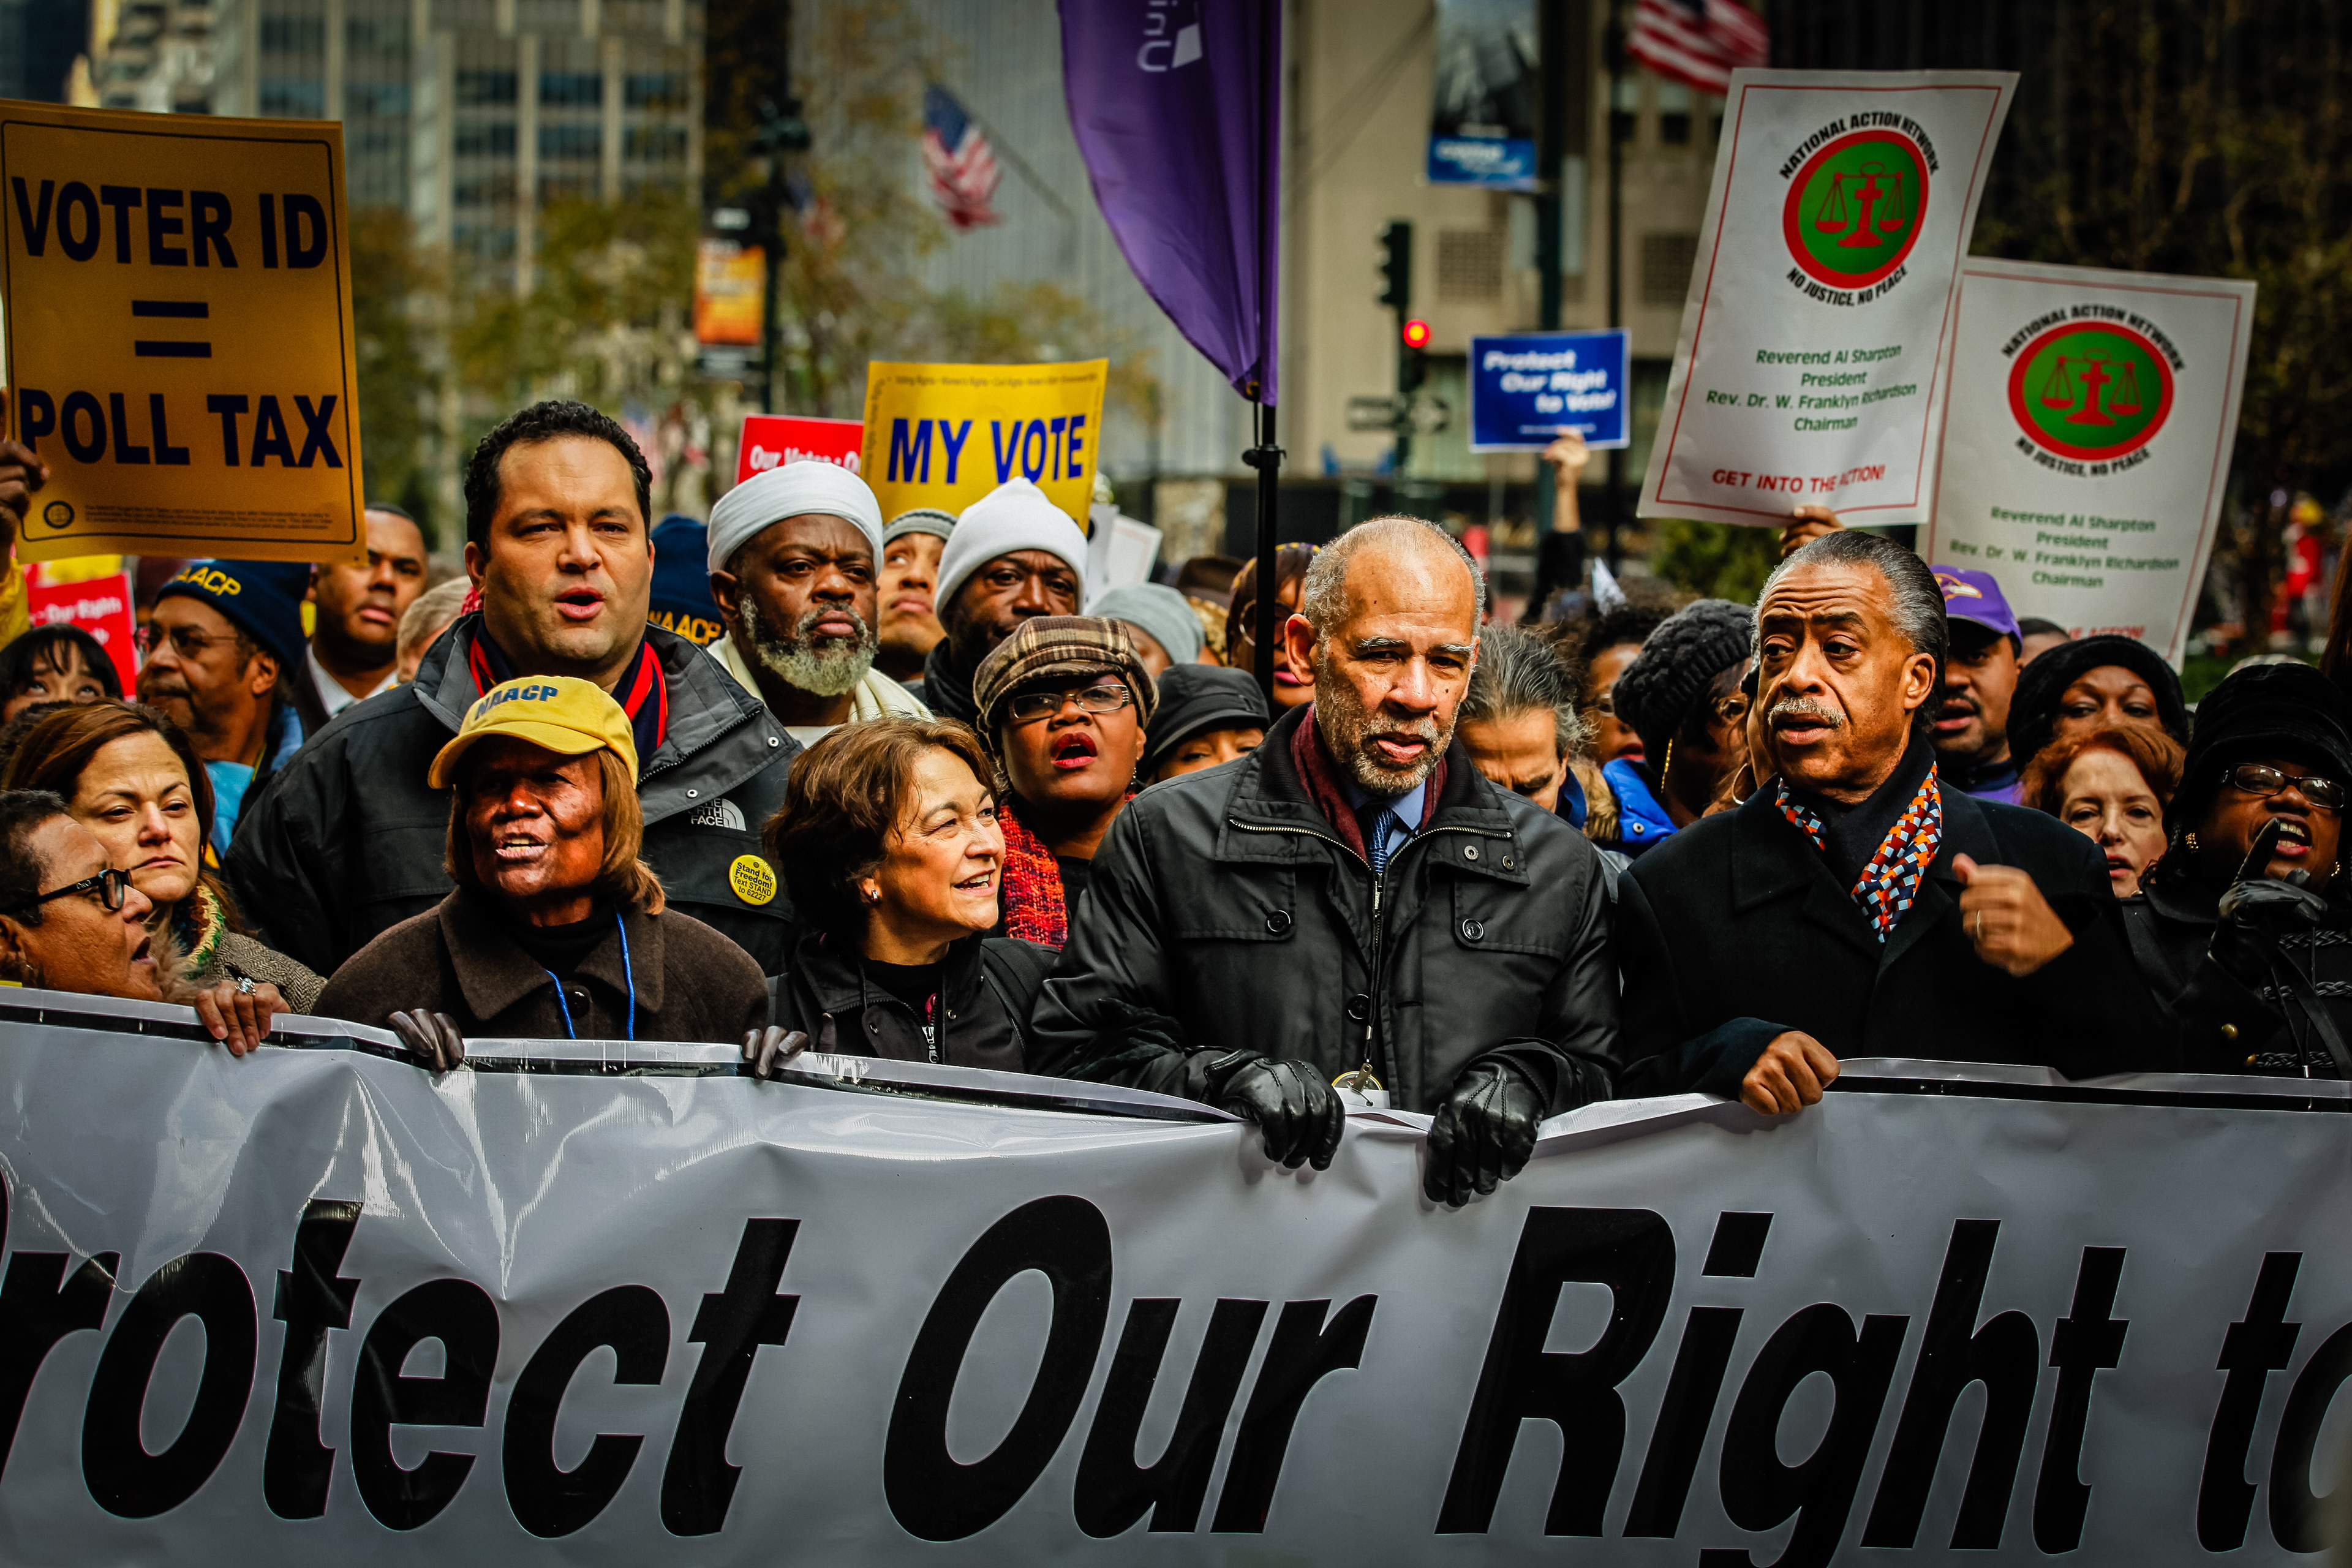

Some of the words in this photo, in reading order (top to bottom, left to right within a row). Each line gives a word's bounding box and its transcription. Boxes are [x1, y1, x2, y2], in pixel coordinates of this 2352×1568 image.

[1779, 119, 1847, 179] NATIONAL
[1850, 111, 1902, 129] ACTION
[1900, 115, 1939, 175] NETWORK
[10, 176, 239, 268] VOTER
[258, 193, 329, 270] ID
[1786, 266, 1806, 289] NO
[1858, 288, 1874, 305] NO
[1875, 263, 1908, 299] PEACE
[2001, 308, 2067, 358] NATIONAL
[2071, 304, 2127, 320] ACTION
[2127, 312, 2185, 372] NETWORK
[1483, 349, 1577, 372] Protect
[1755, 349, 1831, 365] Reverend
[1833, 349, 1849, 364] Al
[1851, 344, 1903, 364] Sharpton
[1500, 371, 1548, 393] Our
[1549, 369, 1608, 394] Right
[1800, 371, 1868, 388] President
[1535, 393, 1564, 414] to
[1706, 389, 1741, 406] Rev.
[1746, 393, 1770, 409] Dr.
[1775, 395, 1793, 409] W.
[1798, 394, 1860, 410] Franklyn
[1861, 383, 1917, 405] Richardson
[19, 388, 191, 466] POLL
[206, 394, 344, 469] TAX
[1793, 416, 1859, 432] Chairman
[887, 418, 973, 484] MY
[990, 415, 1087, 485] VOTE
[2015, 436, 2035, 456] NO
[2090, 463, 2109, 477] NO
[2111, 447, 2150, 473] PEACE
[1712, 469, 1752, 487] GET
[1756, 474, 1804, 494] INTO
[1810, 475, 1838, 493] THE
[1838, 464, 1887, 487] ACTION!
[1991, 505, 2065, 527] Reverend
[2068, 514, 2085, 527] Al
[2088, 514, 2157, 532] Sharpton
[2036, 530, 2109, 549] President
[2035, 551, 2102, 570] Franklyn
[2105, 555, 2180, 570] Richardson
[168, 566, 242, 597] AACP
[2031, 570, 2105, 588] Chairman
[474, 684, 559, 721] NAACP
[690, 815, 724, 827] FACE
[735, 869, 772, 889] Freedom!
[737, 862, 760, 877] Stand
[761, 872, 773, 883] for
[734, 875, 748, 888] Text
[748, 882, 772, 897] STAND
[747, 889, 767, 902] 62227
[0, 1167, 802, 1539] rotect
[883, 1194, 1379, 1544] Our
[1434, 1205, 2130, 1568] Right
